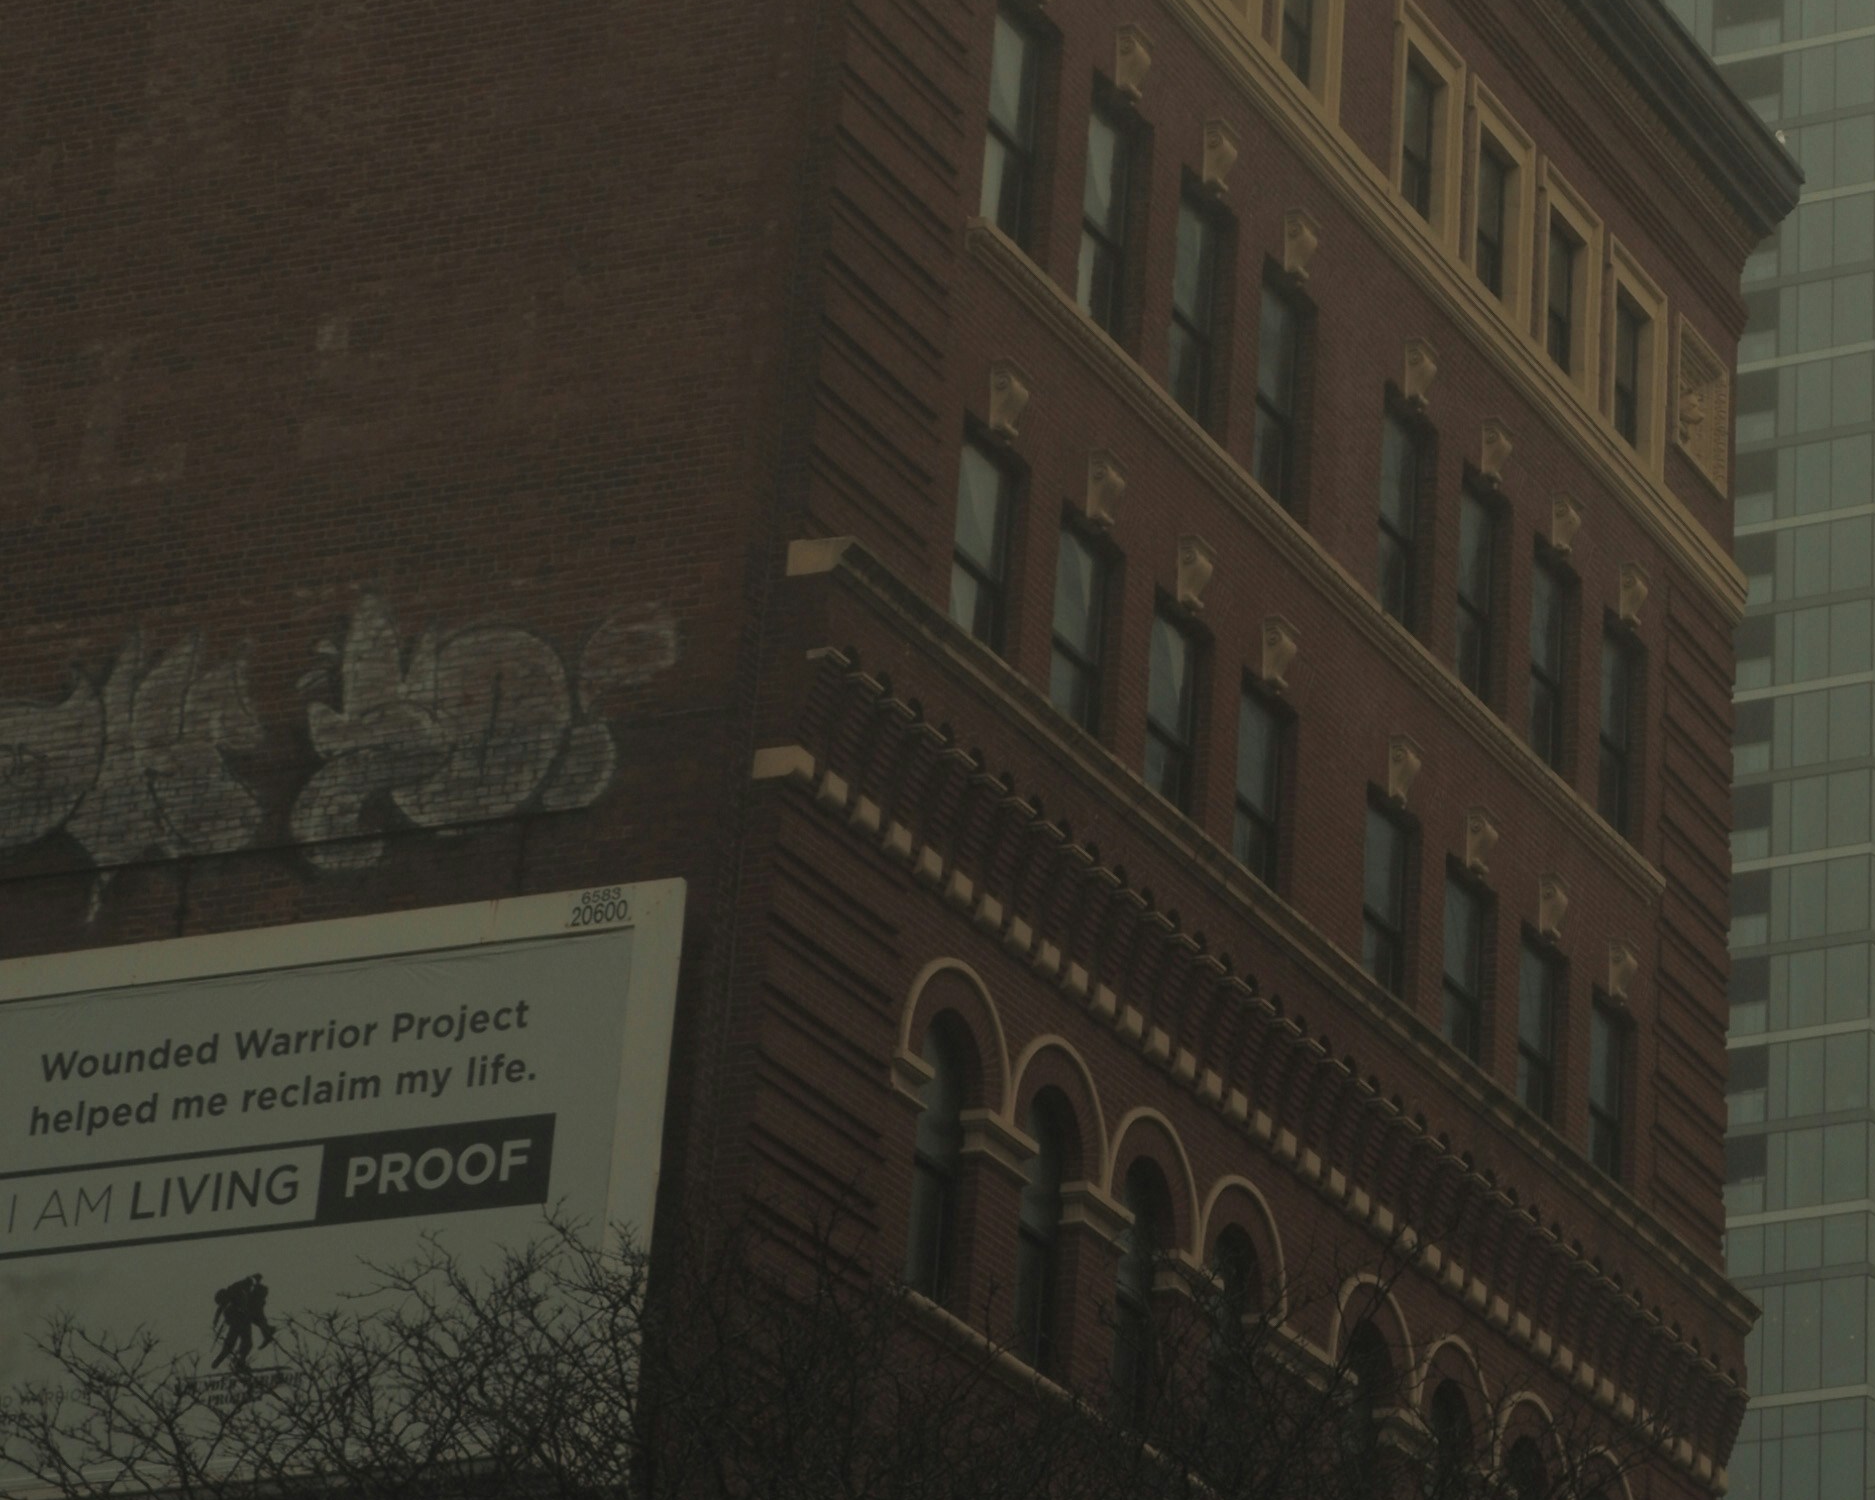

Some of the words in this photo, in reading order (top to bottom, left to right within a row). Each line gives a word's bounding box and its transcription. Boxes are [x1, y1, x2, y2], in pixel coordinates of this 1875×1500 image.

[571, 899, 628, 927] 20600
[581, 887, 622, 906] 6583
[41, 1033, 219, 1083] Wounded
[235, 1020, 378, 1061] Warrior
[392, 999, 530, 1043] Project
[29, 1092, 158, 1136] helped
[172, 1090, 227, 1121] me
[241, 1070, 381, 1114] reclaim
[395, 1064, 452, 1098] my
[466, 1051, 537, 1090] life.
[8, 1193, 17, 1235] I
[33, 1183, 113, 1230] AM
[129, 1163, 299, 1221] LIVING
[344, 1137, 532, 1199] PROOF
